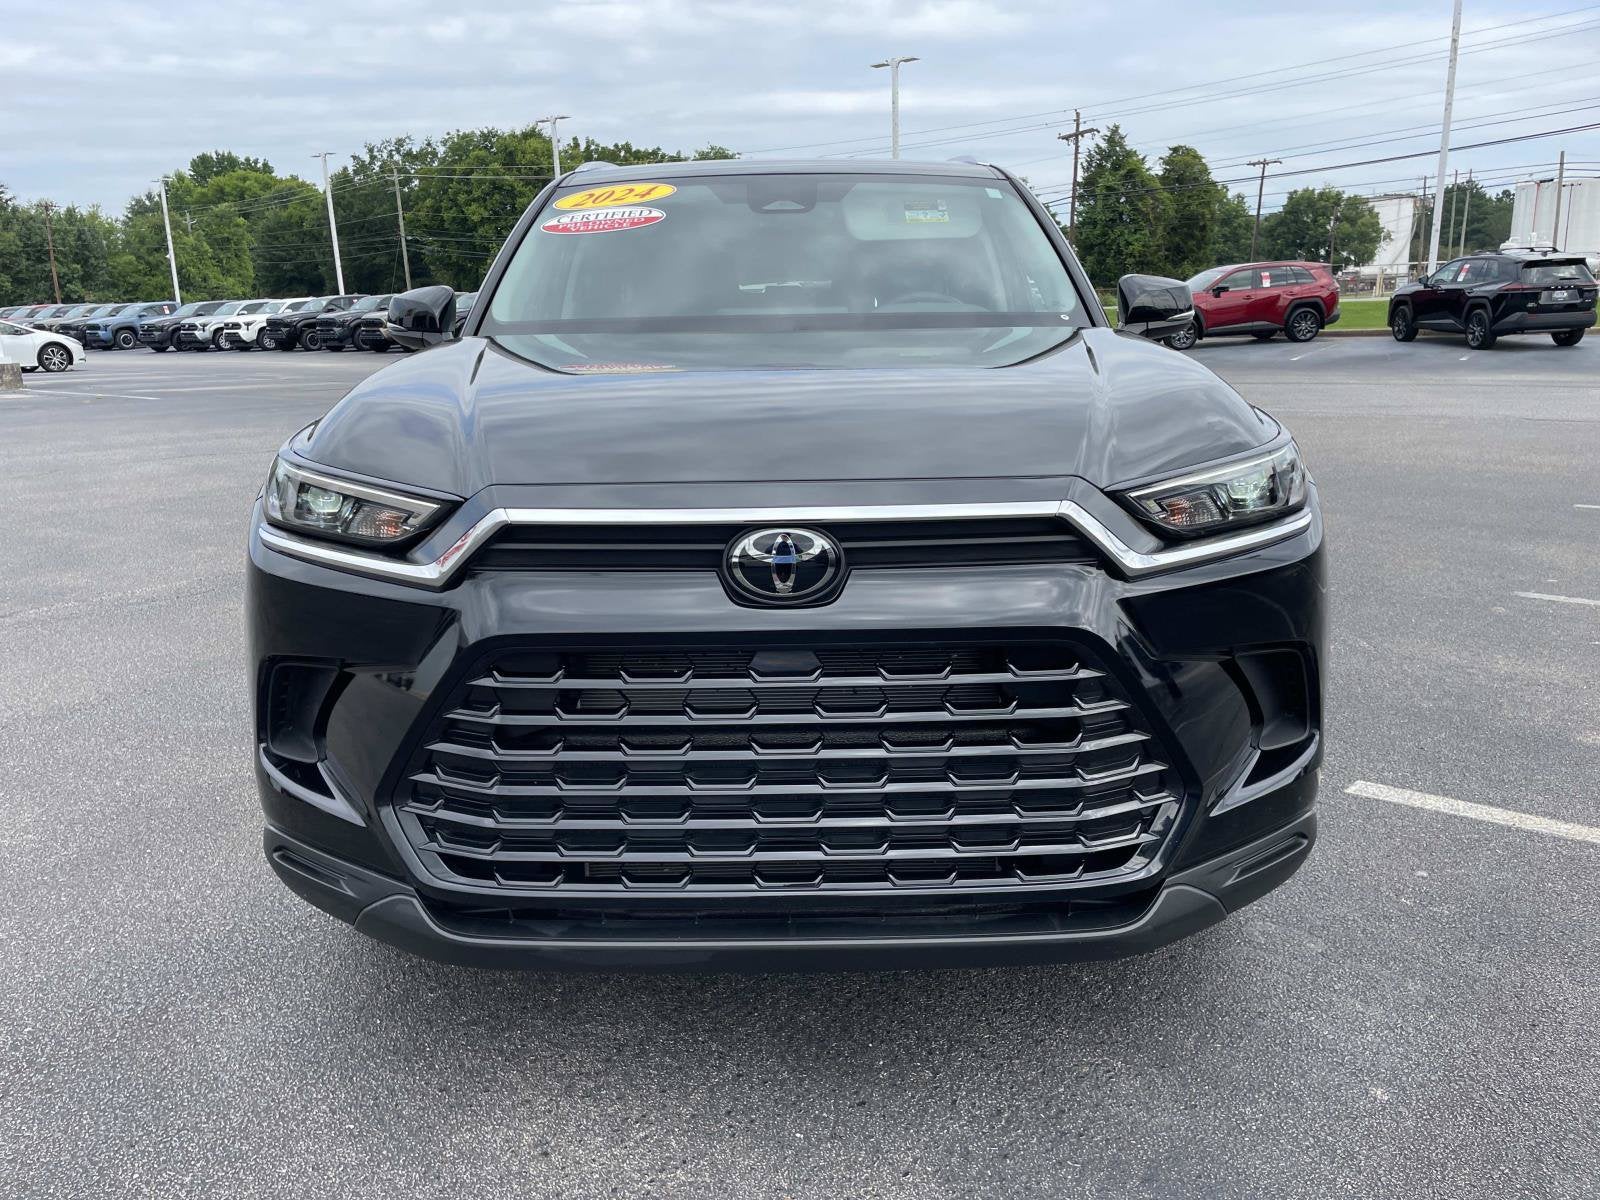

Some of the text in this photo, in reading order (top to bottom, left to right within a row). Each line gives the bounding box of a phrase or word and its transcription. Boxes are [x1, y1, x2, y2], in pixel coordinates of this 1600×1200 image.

[570, 186, 659, 207] 2024
[557, 209, 652, 223] CERTIFIED
[570, 222, 630, 231] VEHICLE
